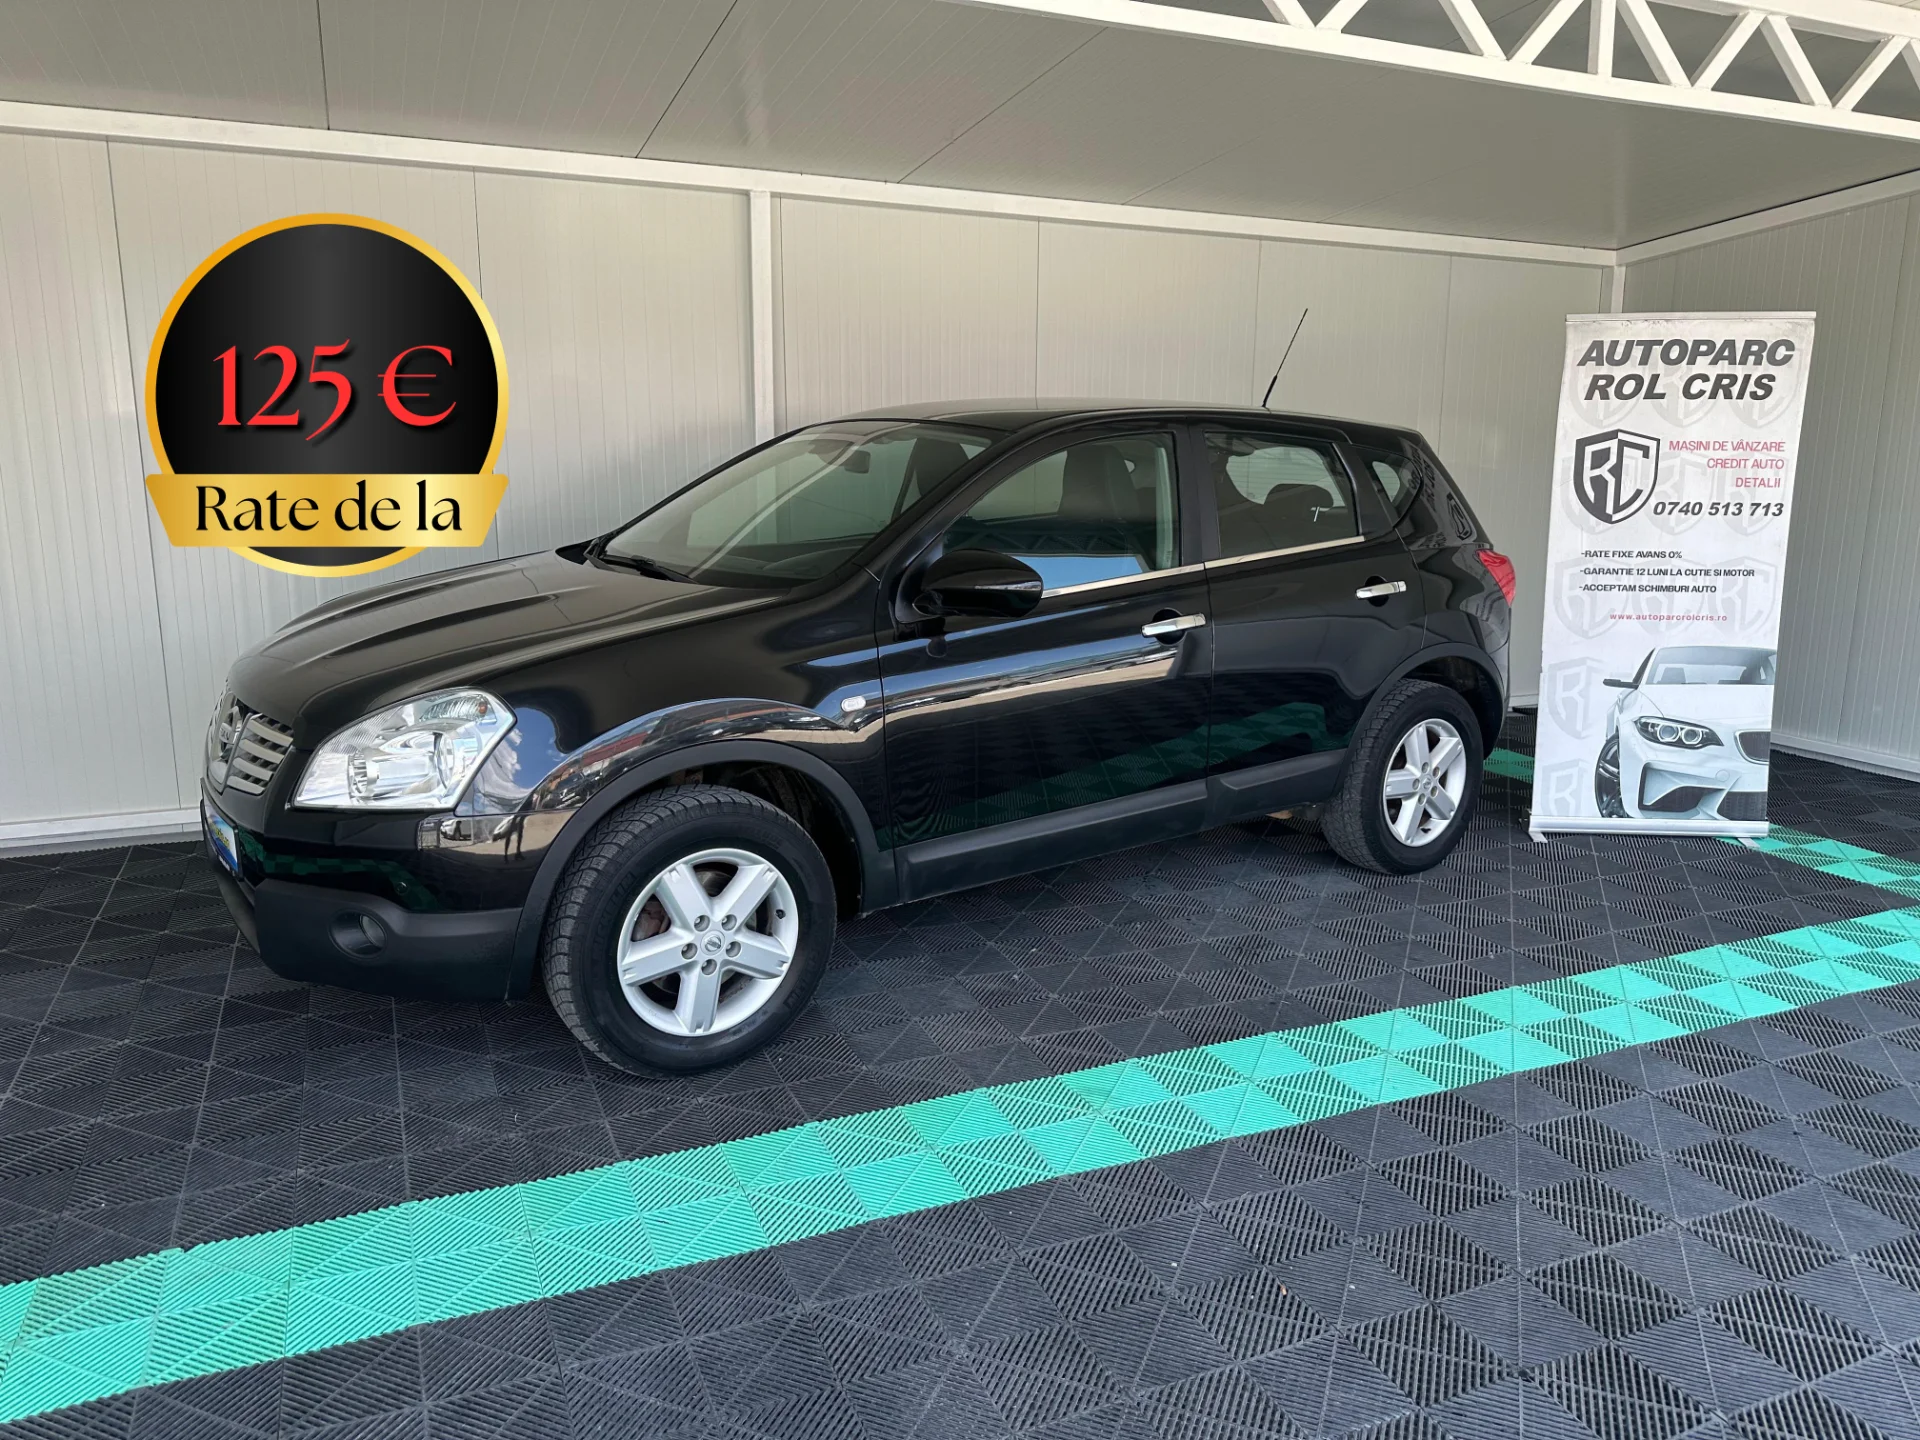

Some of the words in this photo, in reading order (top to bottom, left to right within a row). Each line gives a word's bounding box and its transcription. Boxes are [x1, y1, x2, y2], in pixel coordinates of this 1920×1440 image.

[1577, 339, 1795, 366] AUTOPARC
[1584, 373, 1666, 401] ROL
[1682, 373, 1776, 401] CRIS
[1712, 441, 1728, 451] DE
[1731, 439, 1785, 452] VÂNZARE
[1707, 458, 1749, 469] CREDIT
[1751, 459, 1785, 470] AUTO
[1735, 477, 1780, 488] DETALII
[1653, 501, 1703, 516] 0740
[1708, 502, 1743, 516] 513
[1750, 502, 1784, 517] 713
[1581, 550, 1610, 558] -RATE
[1636, 551, 1666, 559] AVANS
[1668, 551, 1682, 559] 0%
[1636, 568, 1645, 576] 12
[1647, 568, 1669, 576] LUNI
[1684, 569, 1712, 577] CUTIE
[1714, 569, 1722, 577] SI
[1723, 569, 1755, 577] MOTOR
[1638, 585, 1690, 593] SCHIMBURI
[1691, 585, 1717, 593] AUTO
[1610, 613, 1727, 622] www.autoparcrolcris.ro
